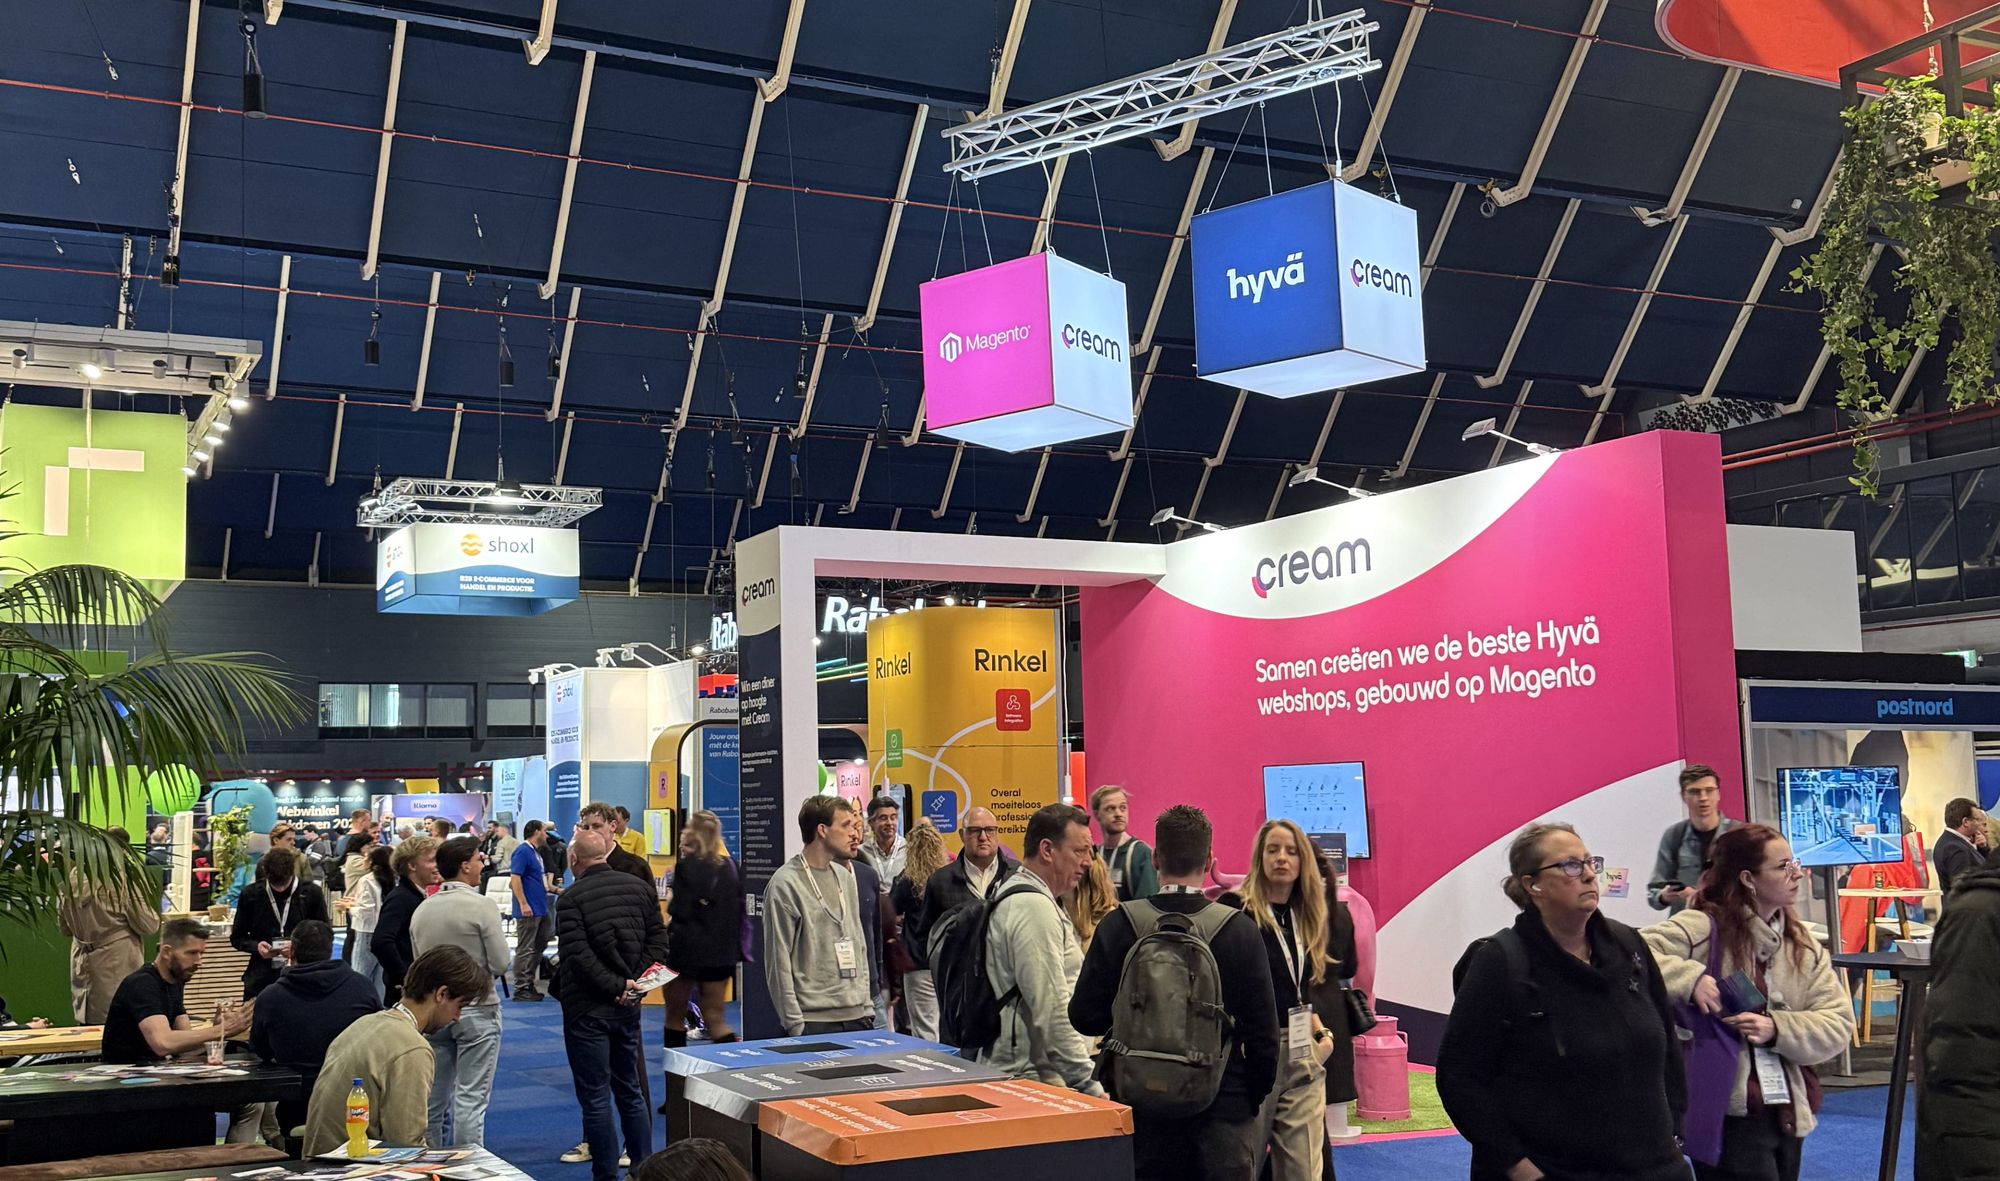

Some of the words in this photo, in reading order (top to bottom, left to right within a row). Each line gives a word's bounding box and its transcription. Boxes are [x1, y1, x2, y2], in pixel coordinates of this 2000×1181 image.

[1226, 251, 1305, 304] hyvä
[1350, 258, 1412, 298] cream
[966, 326, 1030, 352] Magento
[1062, 323, 1121, 362] cream
[488, 536, 534, 554] shoxl
[1252, 537, 1372, 598] cream
[741, 577, 775, 607] cream
[975, 649, 1047, 672] Rinkel
[1255, 657, 1317, 684] Samen
[1321, 646, 1393, 676] creëren
[1398, 642, 1429, 666] we
[1434, 633, 1462, 661] de
[1467, 624, 1531, 655] beste
[1536, 615, 1600, 657] Hyvä
[741, 680, 751, 693] Win
[751, 680, 762, 691] een
[1257, 688, 1352, 717] webshops,
[1355, 671, 1450, 714] gebouwd
[1455, 674, 1485, 704] op
[1489, 661, 1597, 700] Magento
[741, 700, 748, 712] op
[748, 694, 767, 710] hoogte
[1877, 698, 1953, 718] postnord
[990, 788, 1021, 798] Overal
[991, 800, 1042, 810] moeiteloos
